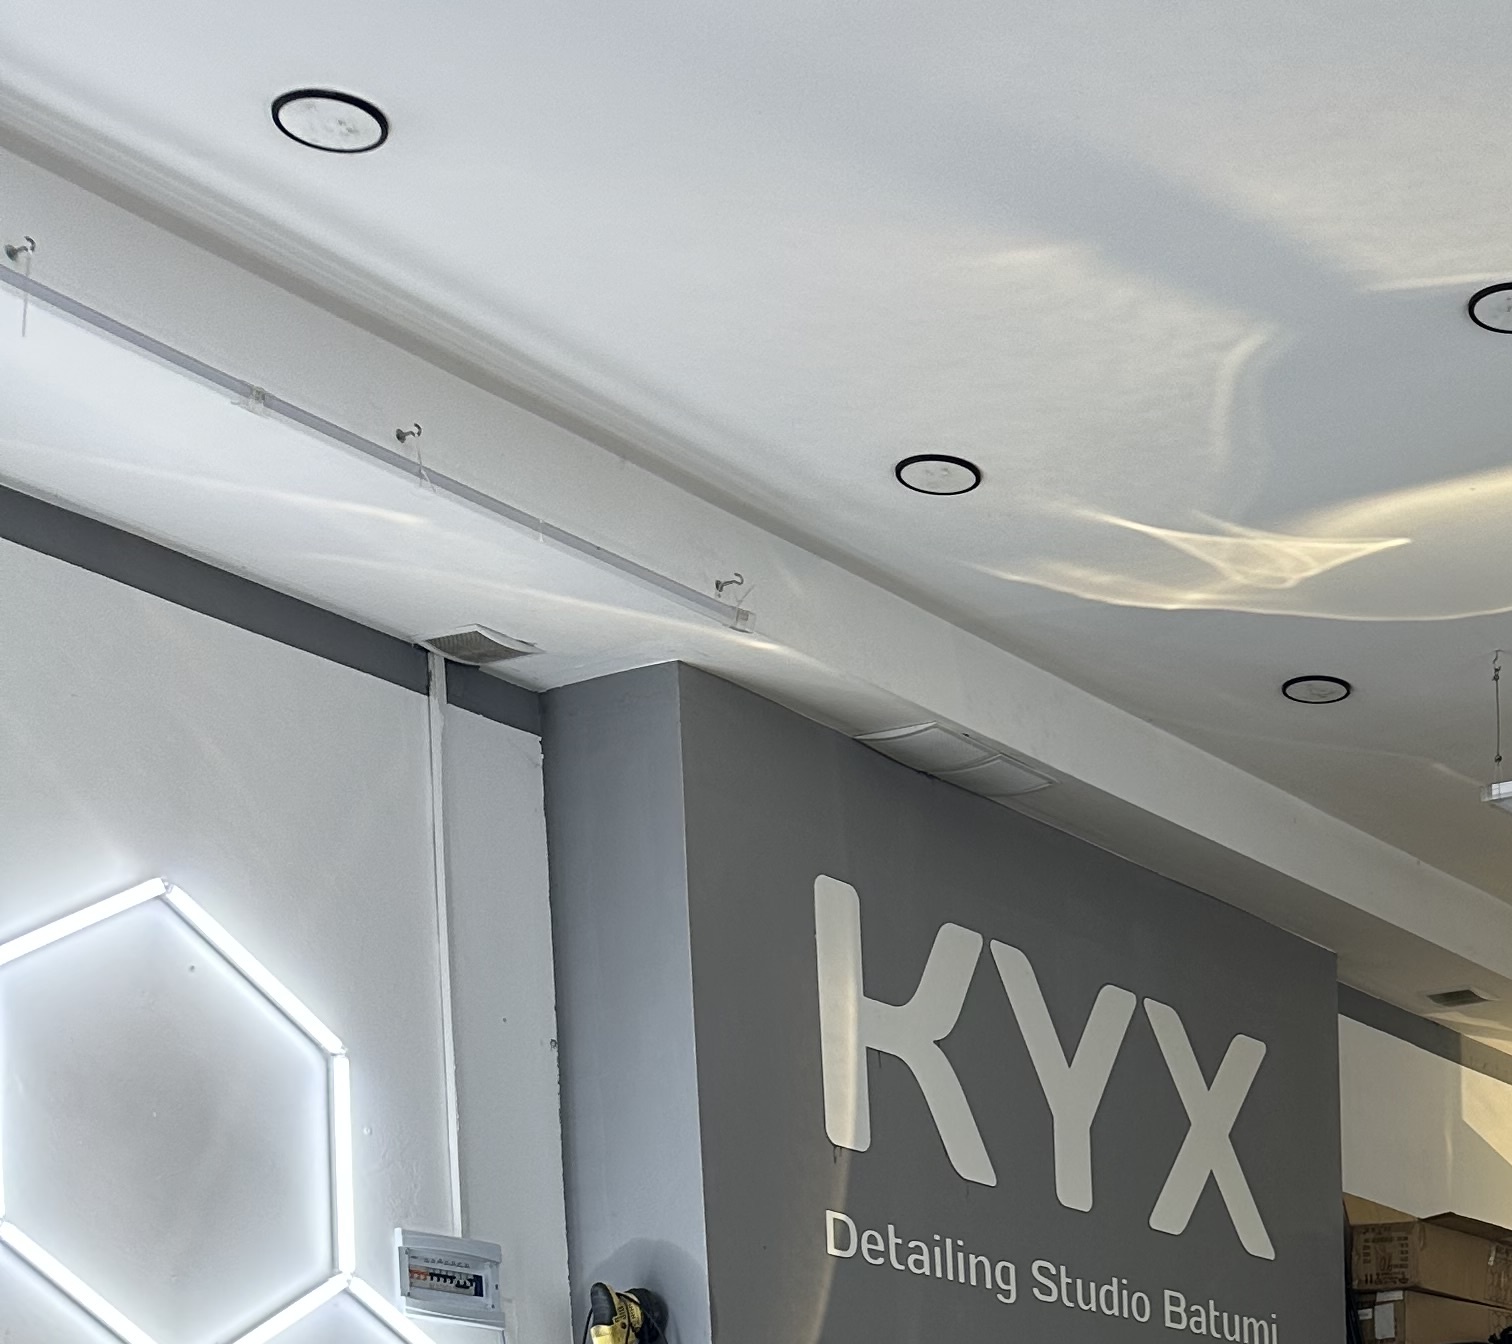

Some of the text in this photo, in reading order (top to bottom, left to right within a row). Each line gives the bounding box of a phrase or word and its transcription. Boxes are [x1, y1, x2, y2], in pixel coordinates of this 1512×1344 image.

[814, 874, 1275, 1261] KYX
[824, 1209, 1018, 1305] Detailing
[1031, 1258, 1152, 1324] Studio
